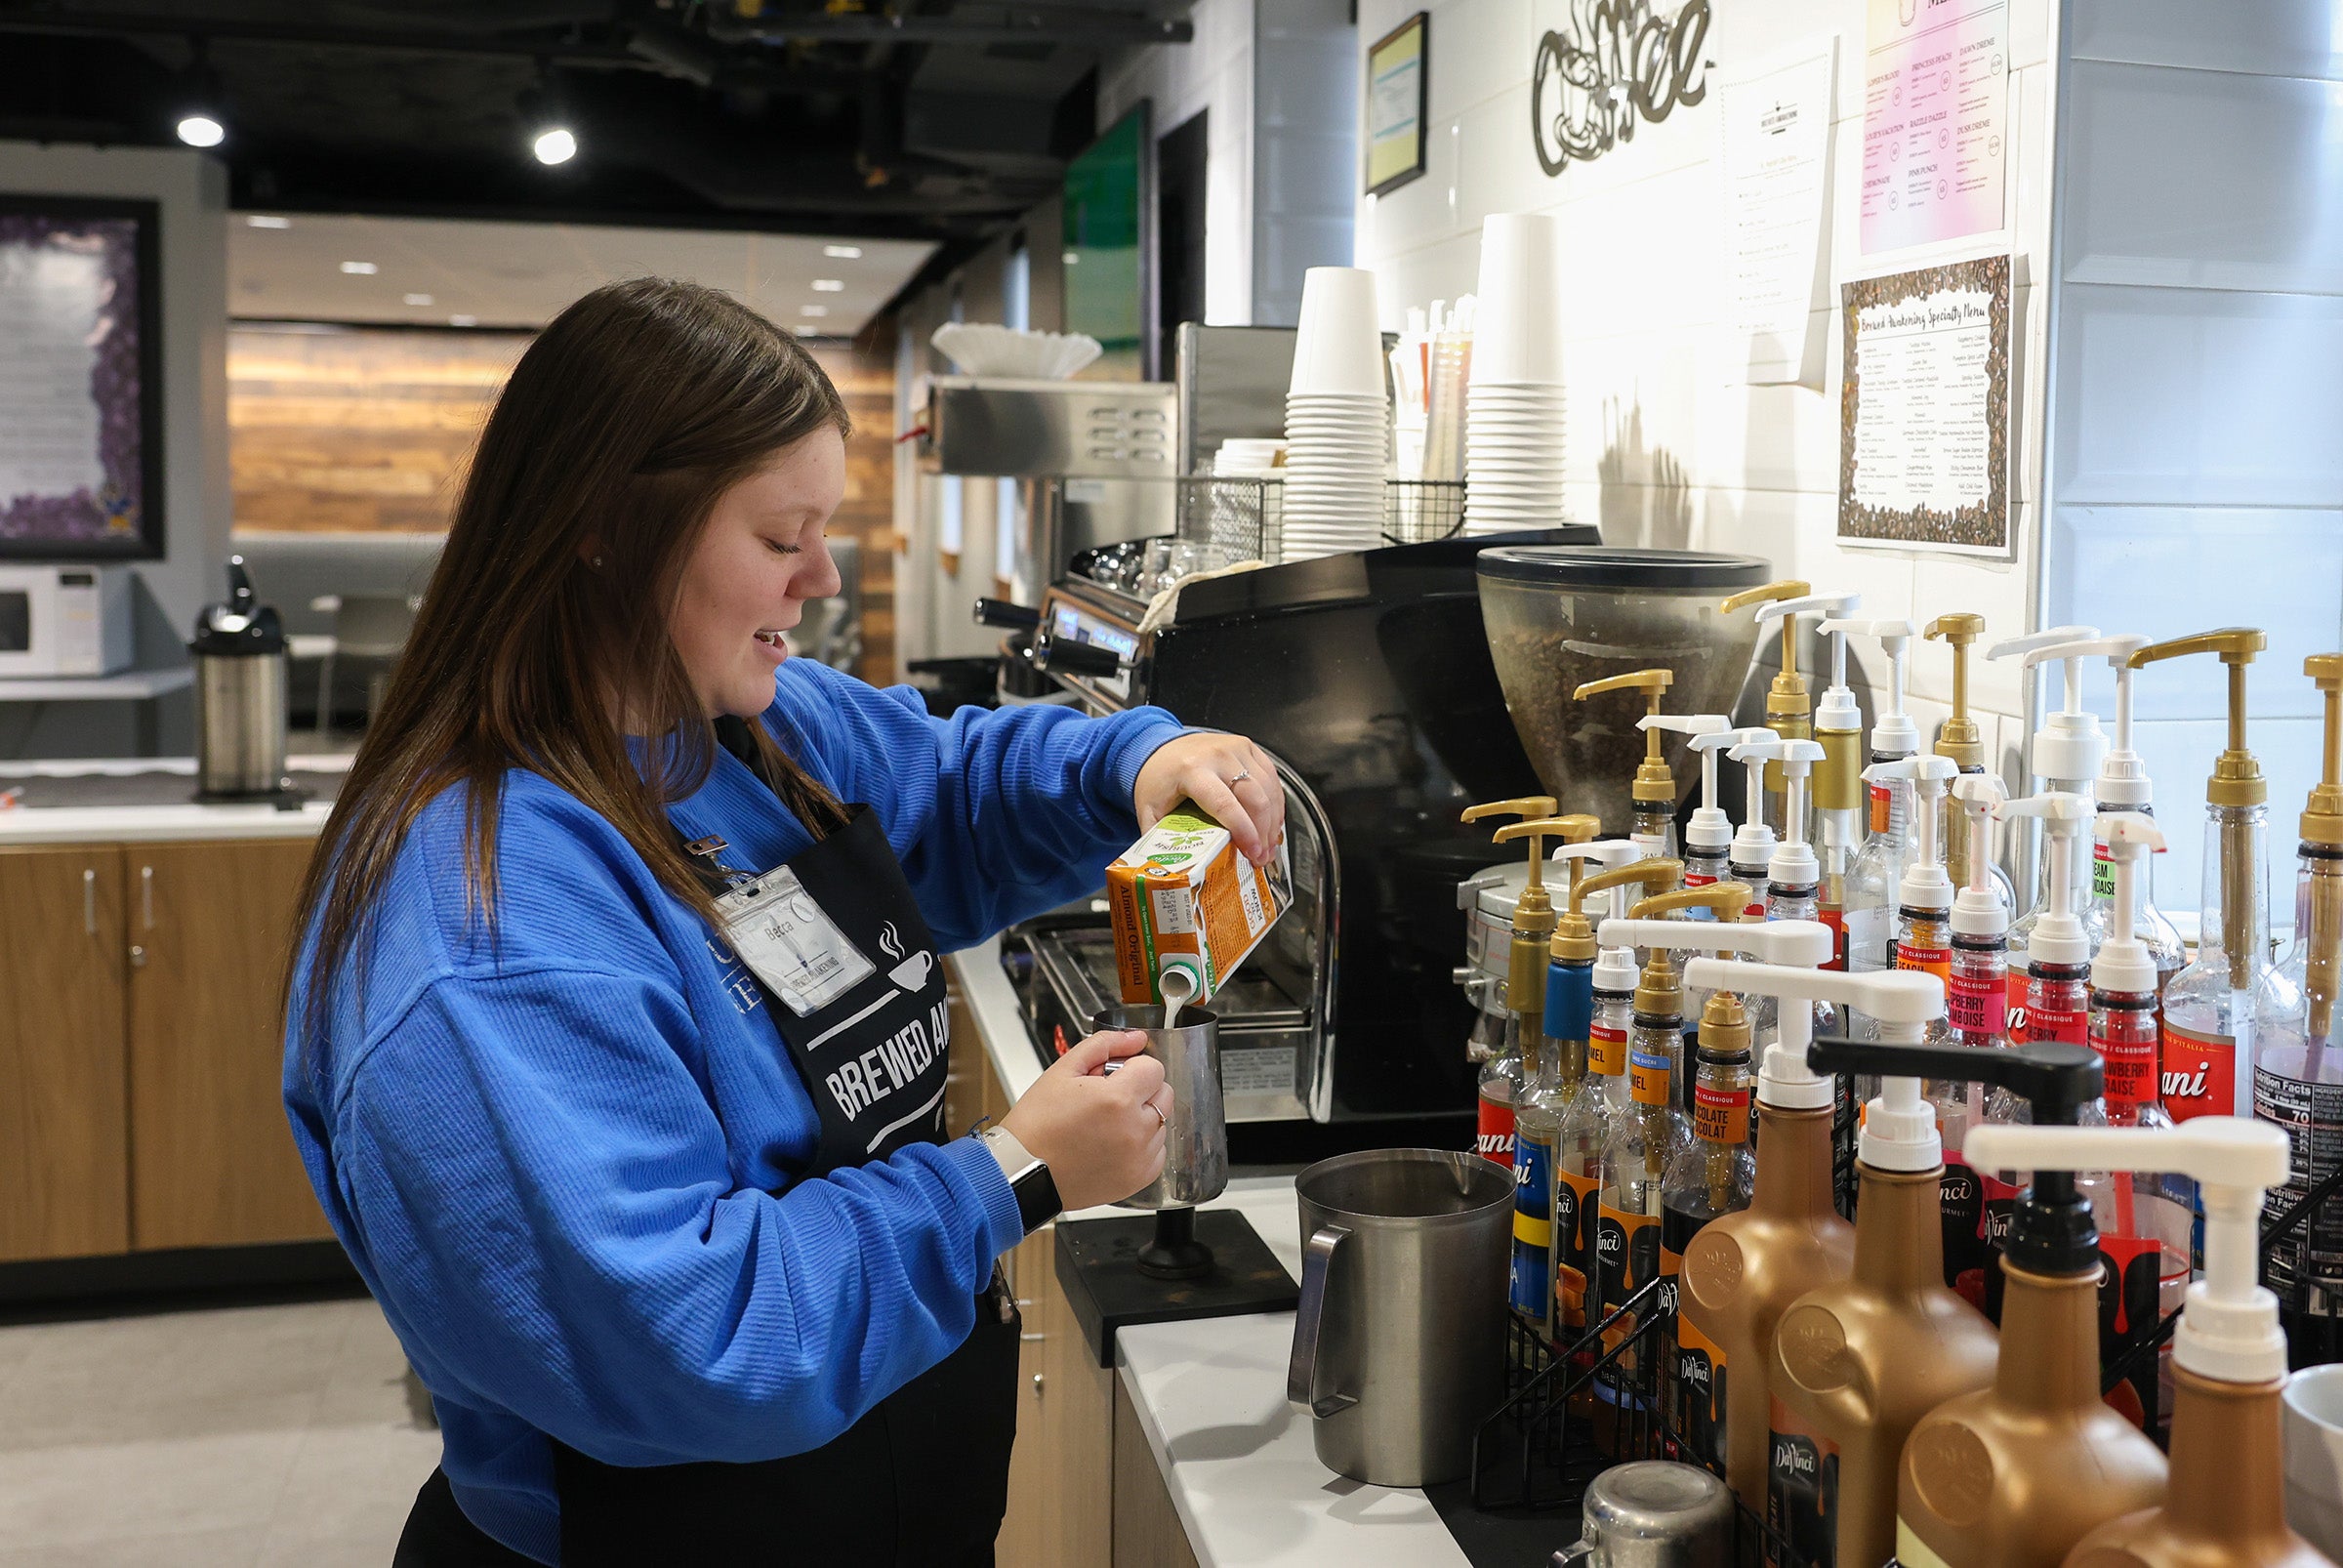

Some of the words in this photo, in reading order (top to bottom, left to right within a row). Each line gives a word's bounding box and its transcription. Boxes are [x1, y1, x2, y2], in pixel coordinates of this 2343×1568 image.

[1862, 315, 1886, 332] Brewed
[1928, 305, 1962, 328] Specialty
[1963, 303, 1985, 318] Menu
[1120, 885, 1137, 931] Almond
[764, 920, 795, 941] Becca
[1128, 932, 1143, 986] Original
[1909, 951, 1941, 960] CLASSIQUE
[1957, 980, 1991, 990] CLASSIQUE
[2036, 1013, 2074, 1023] CLASSIQUE
[2115, 1046, 2152, 1054] CLASSIQUE
[825, 1018, 933, 1122] BREWED
[1702, 1093, 1734, 1104] CLASSIQUE
[2291, 1109, 2310, 1124] 70
[1681, 1355, 1709, 1385] DaVinci
[1776, 1442, 1815, 1475] DaVinci
